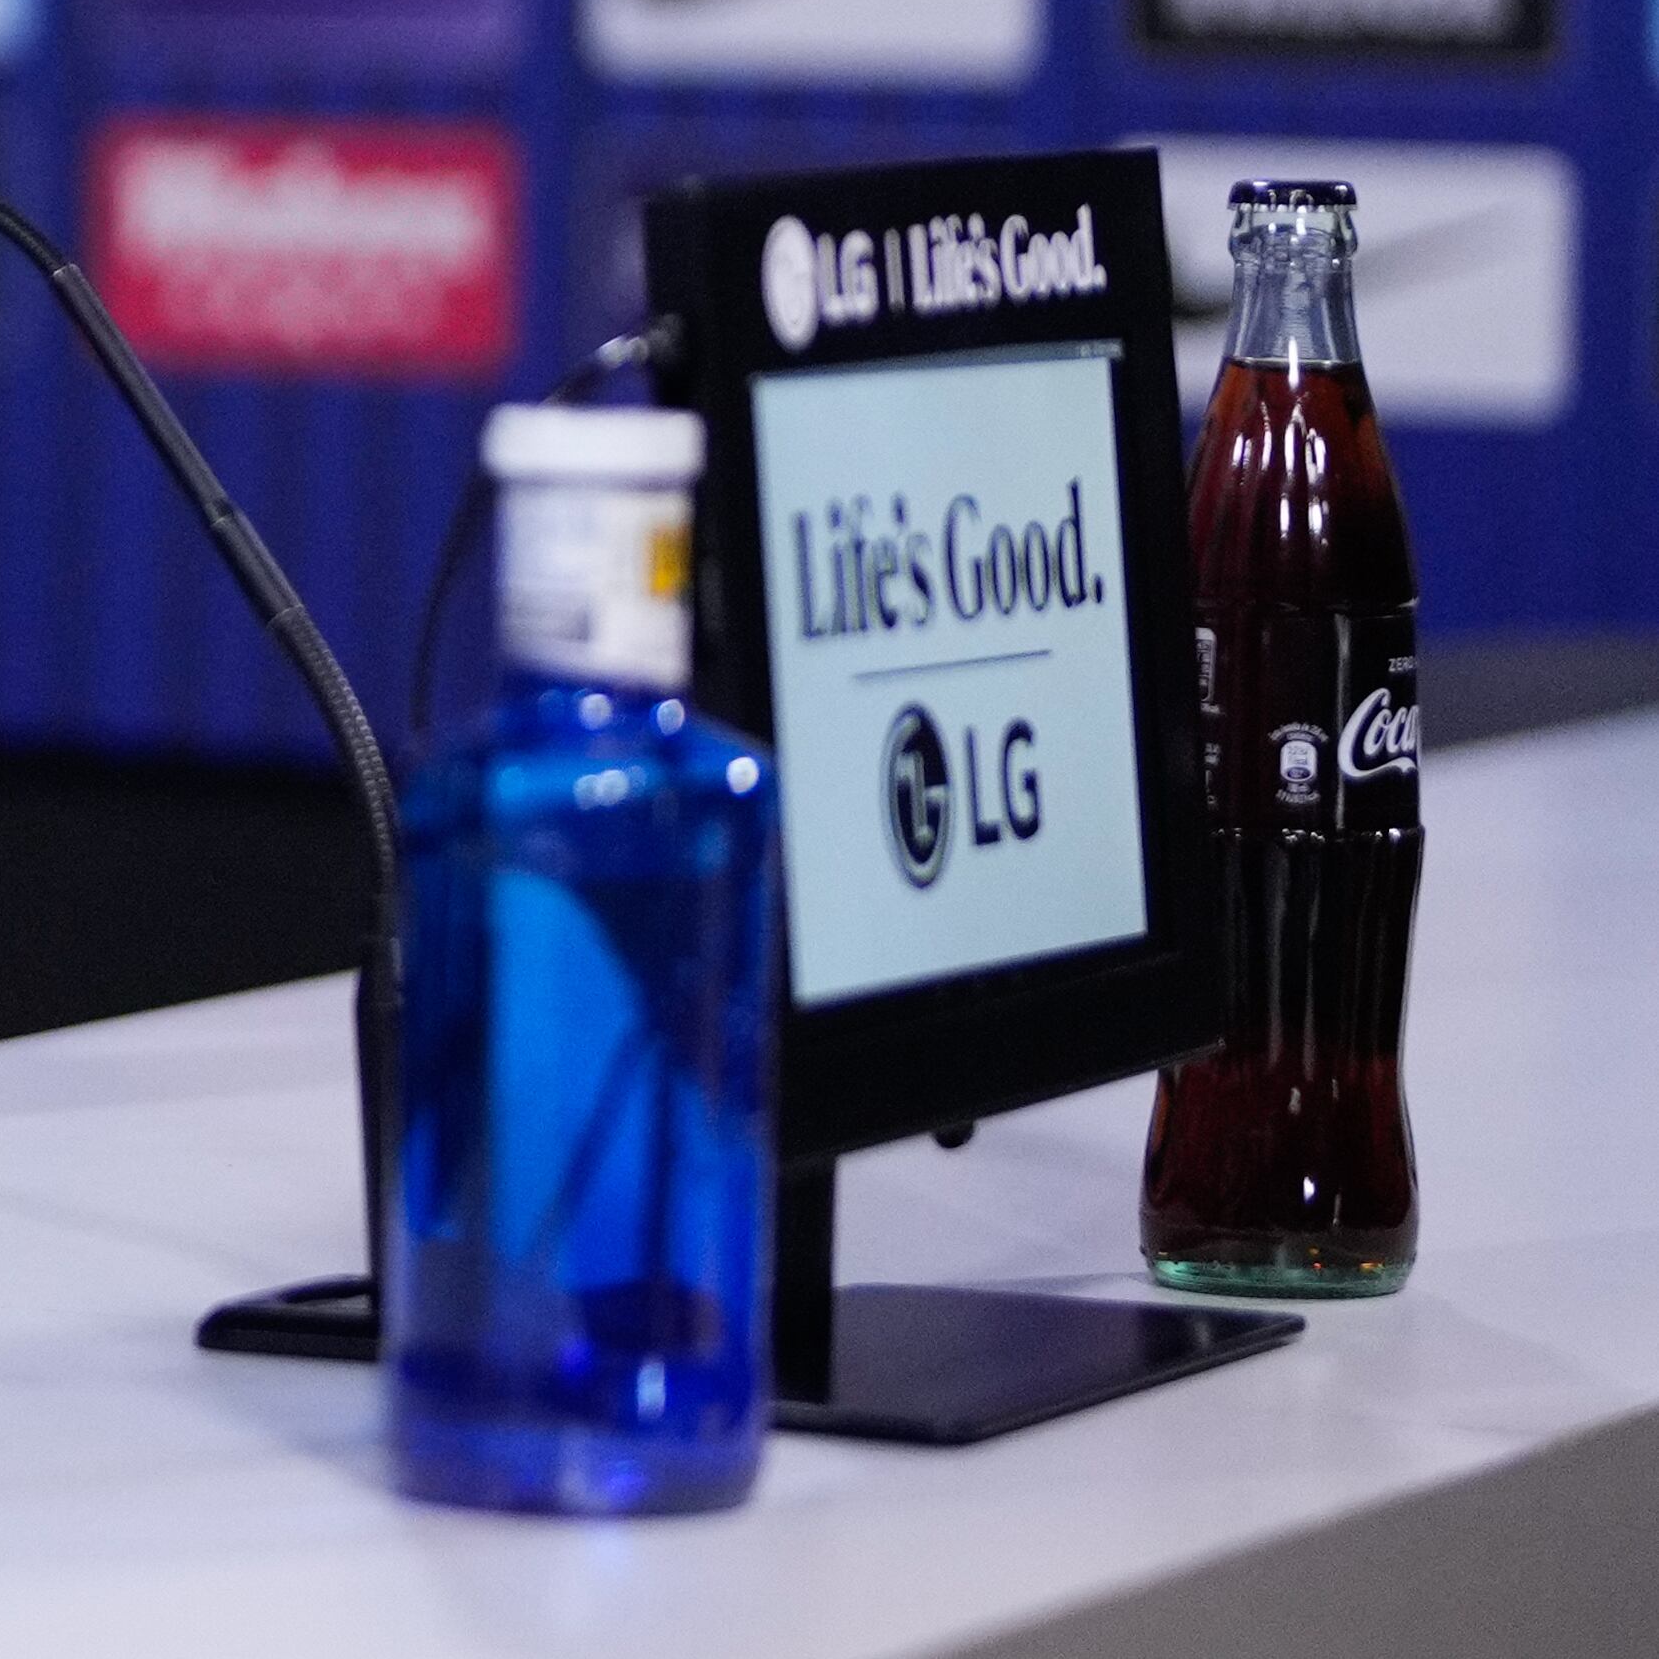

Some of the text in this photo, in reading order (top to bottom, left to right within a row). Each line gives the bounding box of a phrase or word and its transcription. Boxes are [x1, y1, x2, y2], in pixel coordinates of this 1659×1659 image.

[817, 203, 1108, 325] LG Life's Good.
[791, 473, 1105, 640] Life's Good.
[965, 716, 1042, 848] LG
